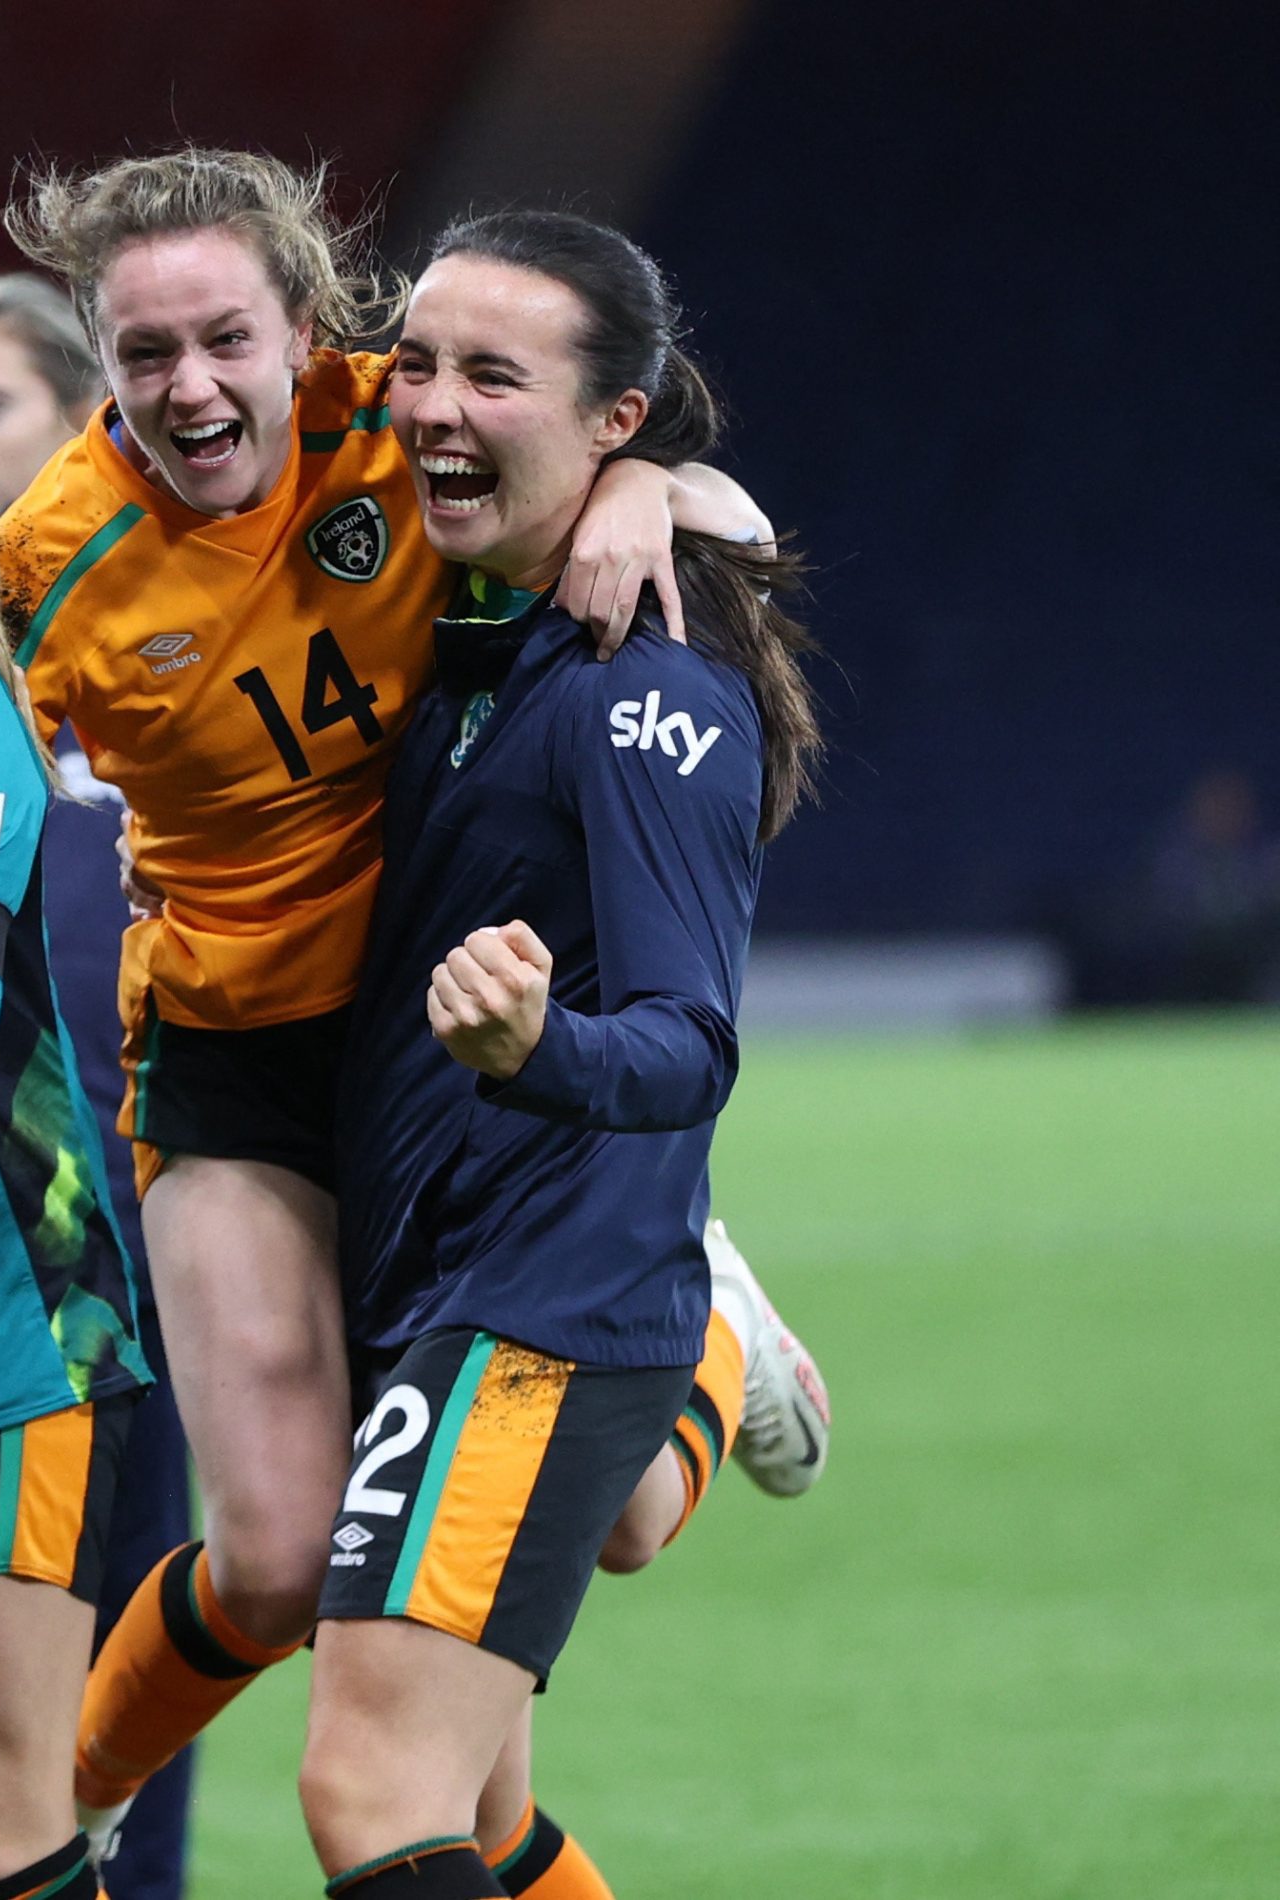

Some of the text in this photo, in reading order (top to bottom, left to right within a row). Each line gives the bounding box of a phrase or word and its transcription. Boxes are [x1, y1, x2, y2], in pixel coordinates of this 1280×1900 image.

[320, 506, 366, 542] Ireland
[151, 651, 201, 675] umbro
[233, 626, 385, 782] 14
[609, 689, 722, 776] sky
